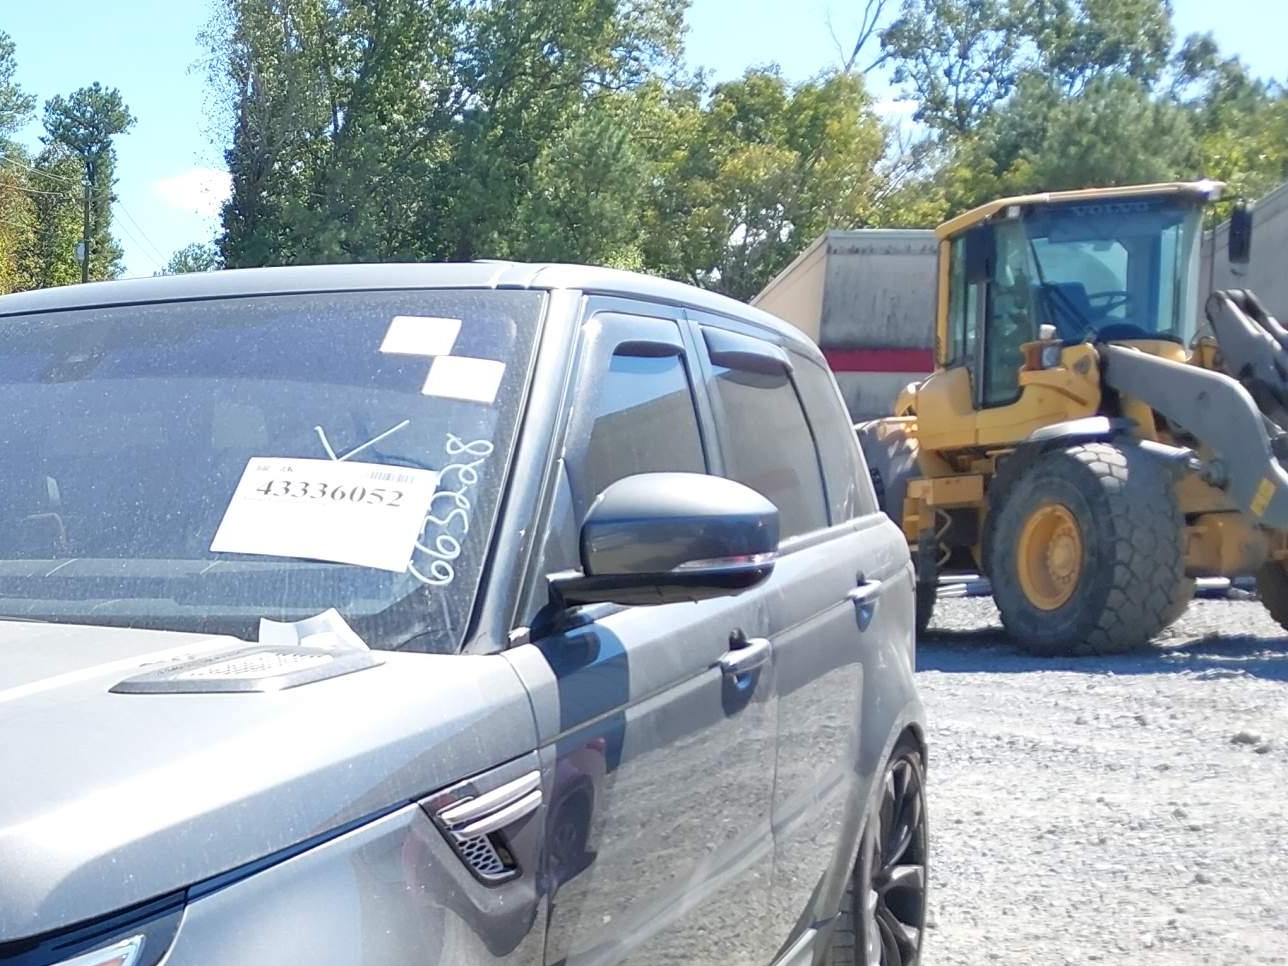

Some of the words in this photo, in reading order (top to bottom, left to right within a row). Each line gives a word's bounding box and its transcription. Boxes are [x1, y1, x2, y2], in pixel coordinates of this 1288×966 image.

[1070, 201, 1151, 217] VOLVO
[256, 479, 404, 507] 43336052
[408, 432, 495, 585] 663228
